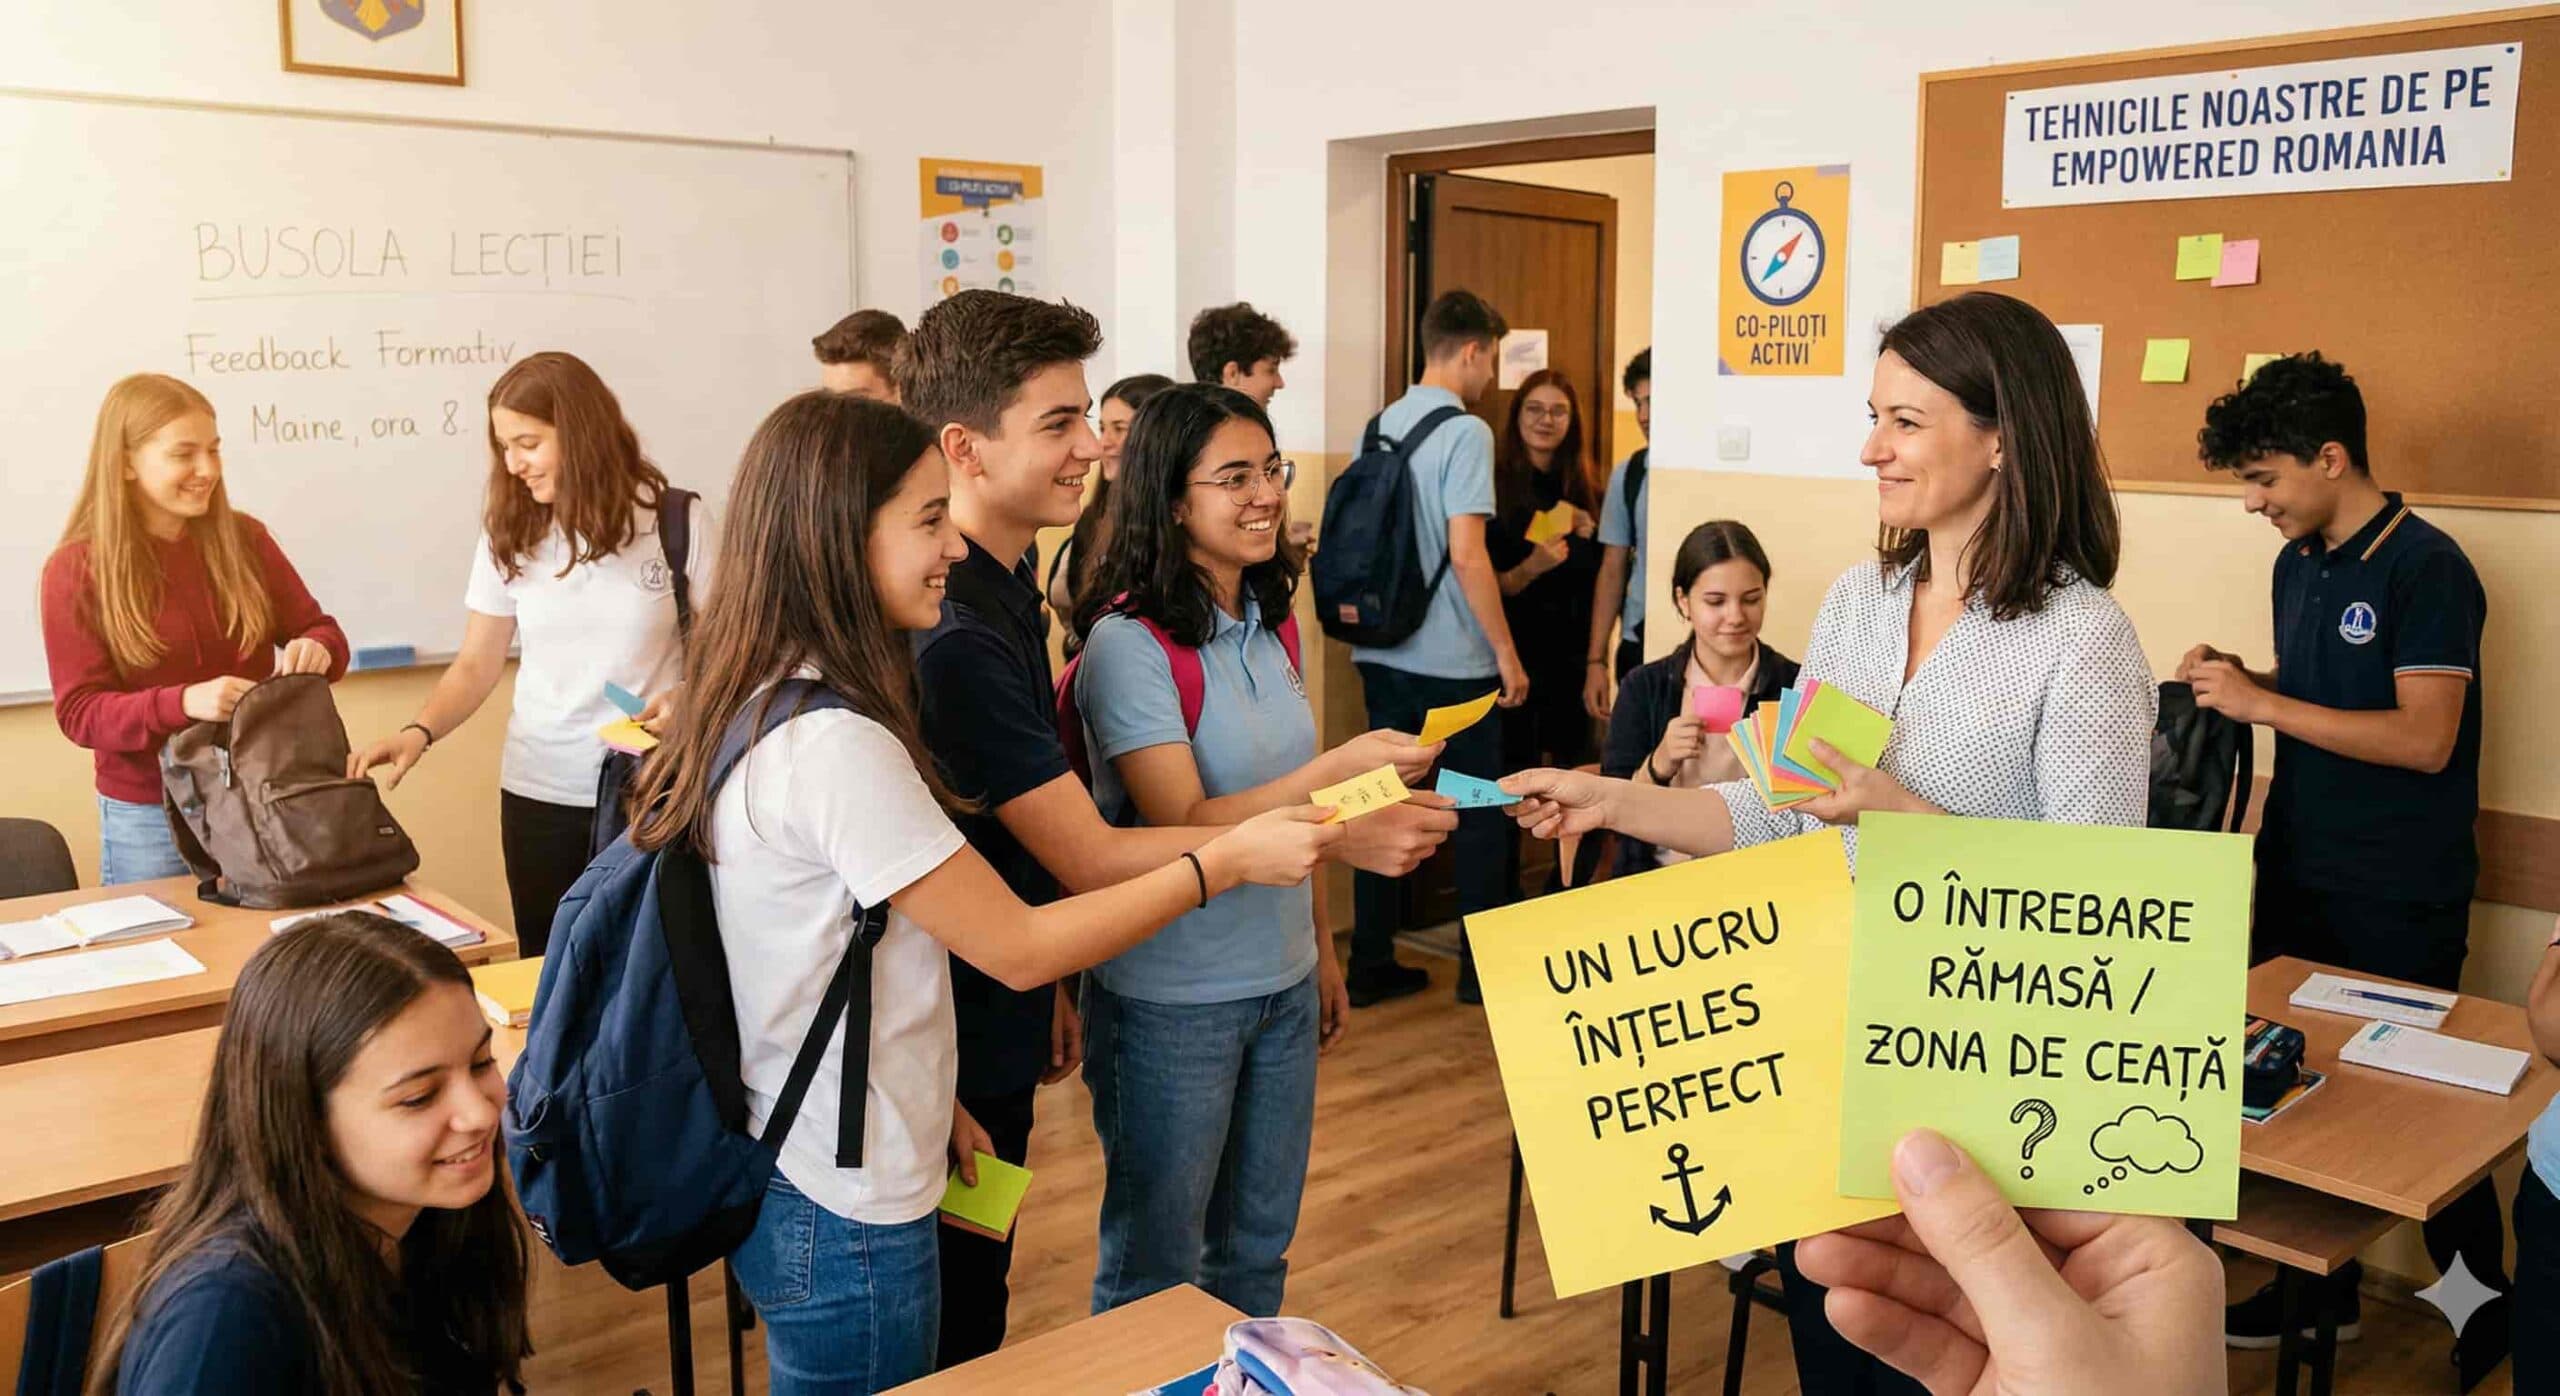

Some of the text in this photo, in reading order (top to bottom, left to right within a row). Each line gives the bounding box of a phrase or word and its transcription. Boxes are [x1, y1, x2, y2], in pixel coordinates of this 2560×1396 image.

[2024, 65, 2493, 142] TEHNICILE NOASTRE DE PE
[2052, 124, 2446, 187] EMPOWERED ROMANIA
[193, 222, 409, 282] BUSOLA
[184, 329, 517, 376] Feedback Formativ
[1736, 314, 1827, 344] CO-PILOȚI
[1750, 342, 1810, 365] ACTIVI
[251, 402, 359, 449] Maine,
[370, 416, 420, 439] ora
[1894, 870, 2194, 943] O ÎNTREBARE
[1544, 901, 1779, 995] UN LUCRU
[1929, 945, 2155, 1015] RĂMASĂ /
[1565, 983, 1761, 1068] ÎNȚELES
[1587, 1052, 1785, 1140] PERFECT
[1865, 1024, 2227, 1102] ZONA DE CEAȚĂ
